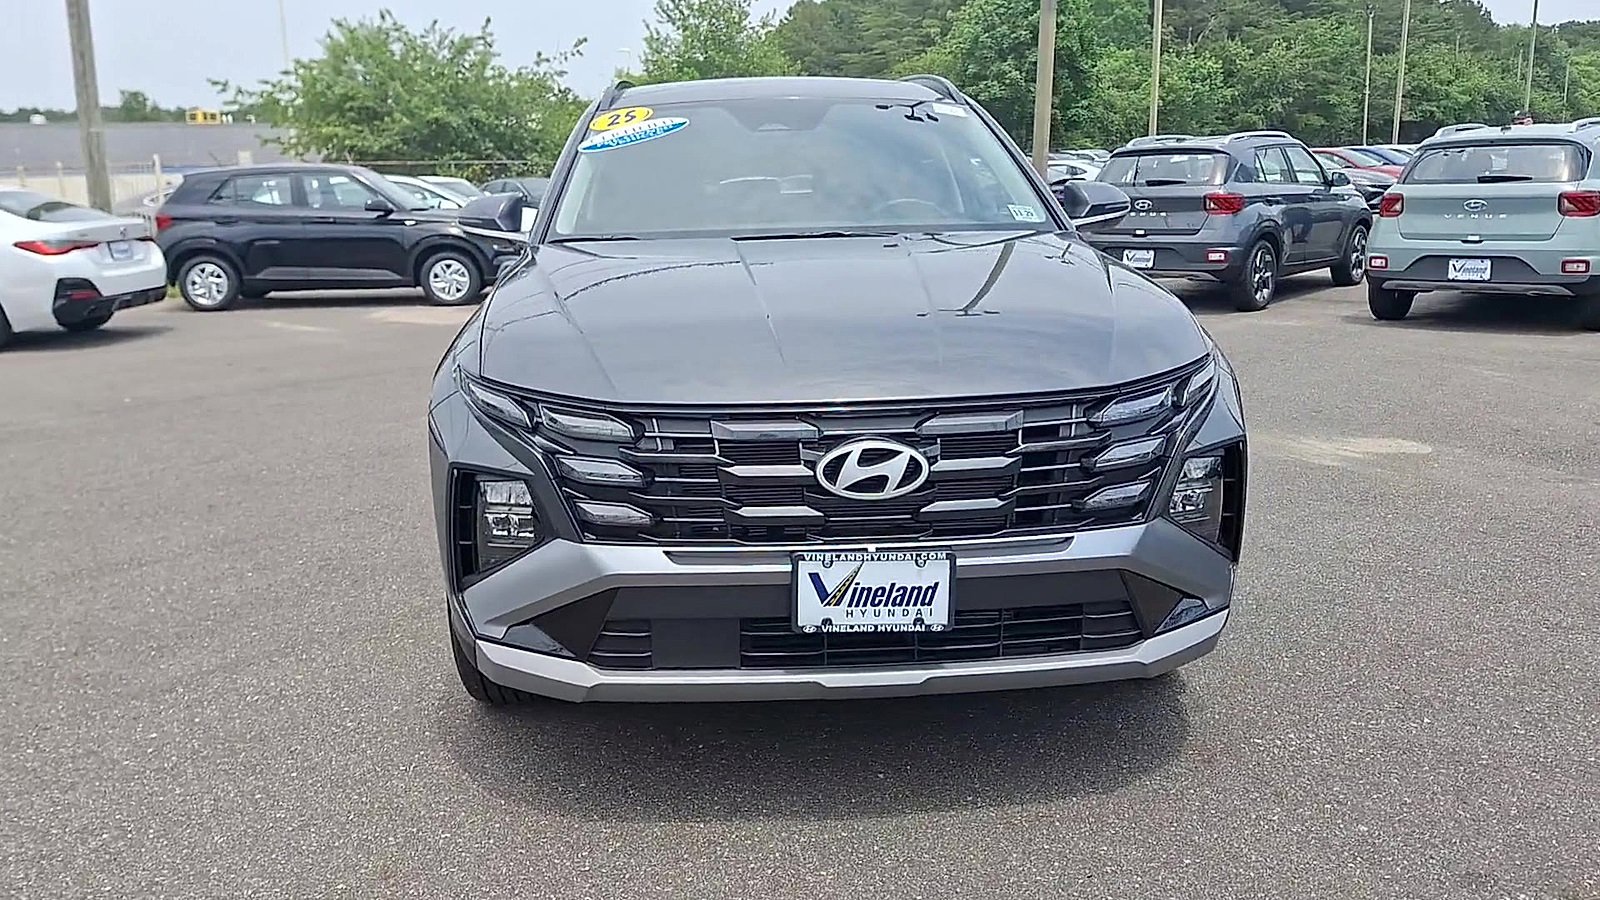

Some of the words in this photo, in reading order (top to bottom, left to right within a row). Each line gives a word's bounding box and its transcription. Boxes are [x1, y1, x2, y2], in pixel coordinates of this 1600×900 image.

[607, 109, 638, 127] 25
[804, 552, 947, 561] VINELANDHYUNDAI.COM
[808, 561, 940, 608] Vineland
[845, 607, 933, 618] HYUNDAI
[821, 624, 876, 633] VINELAND
[877, 624, 926, 632] HYUNDAI
